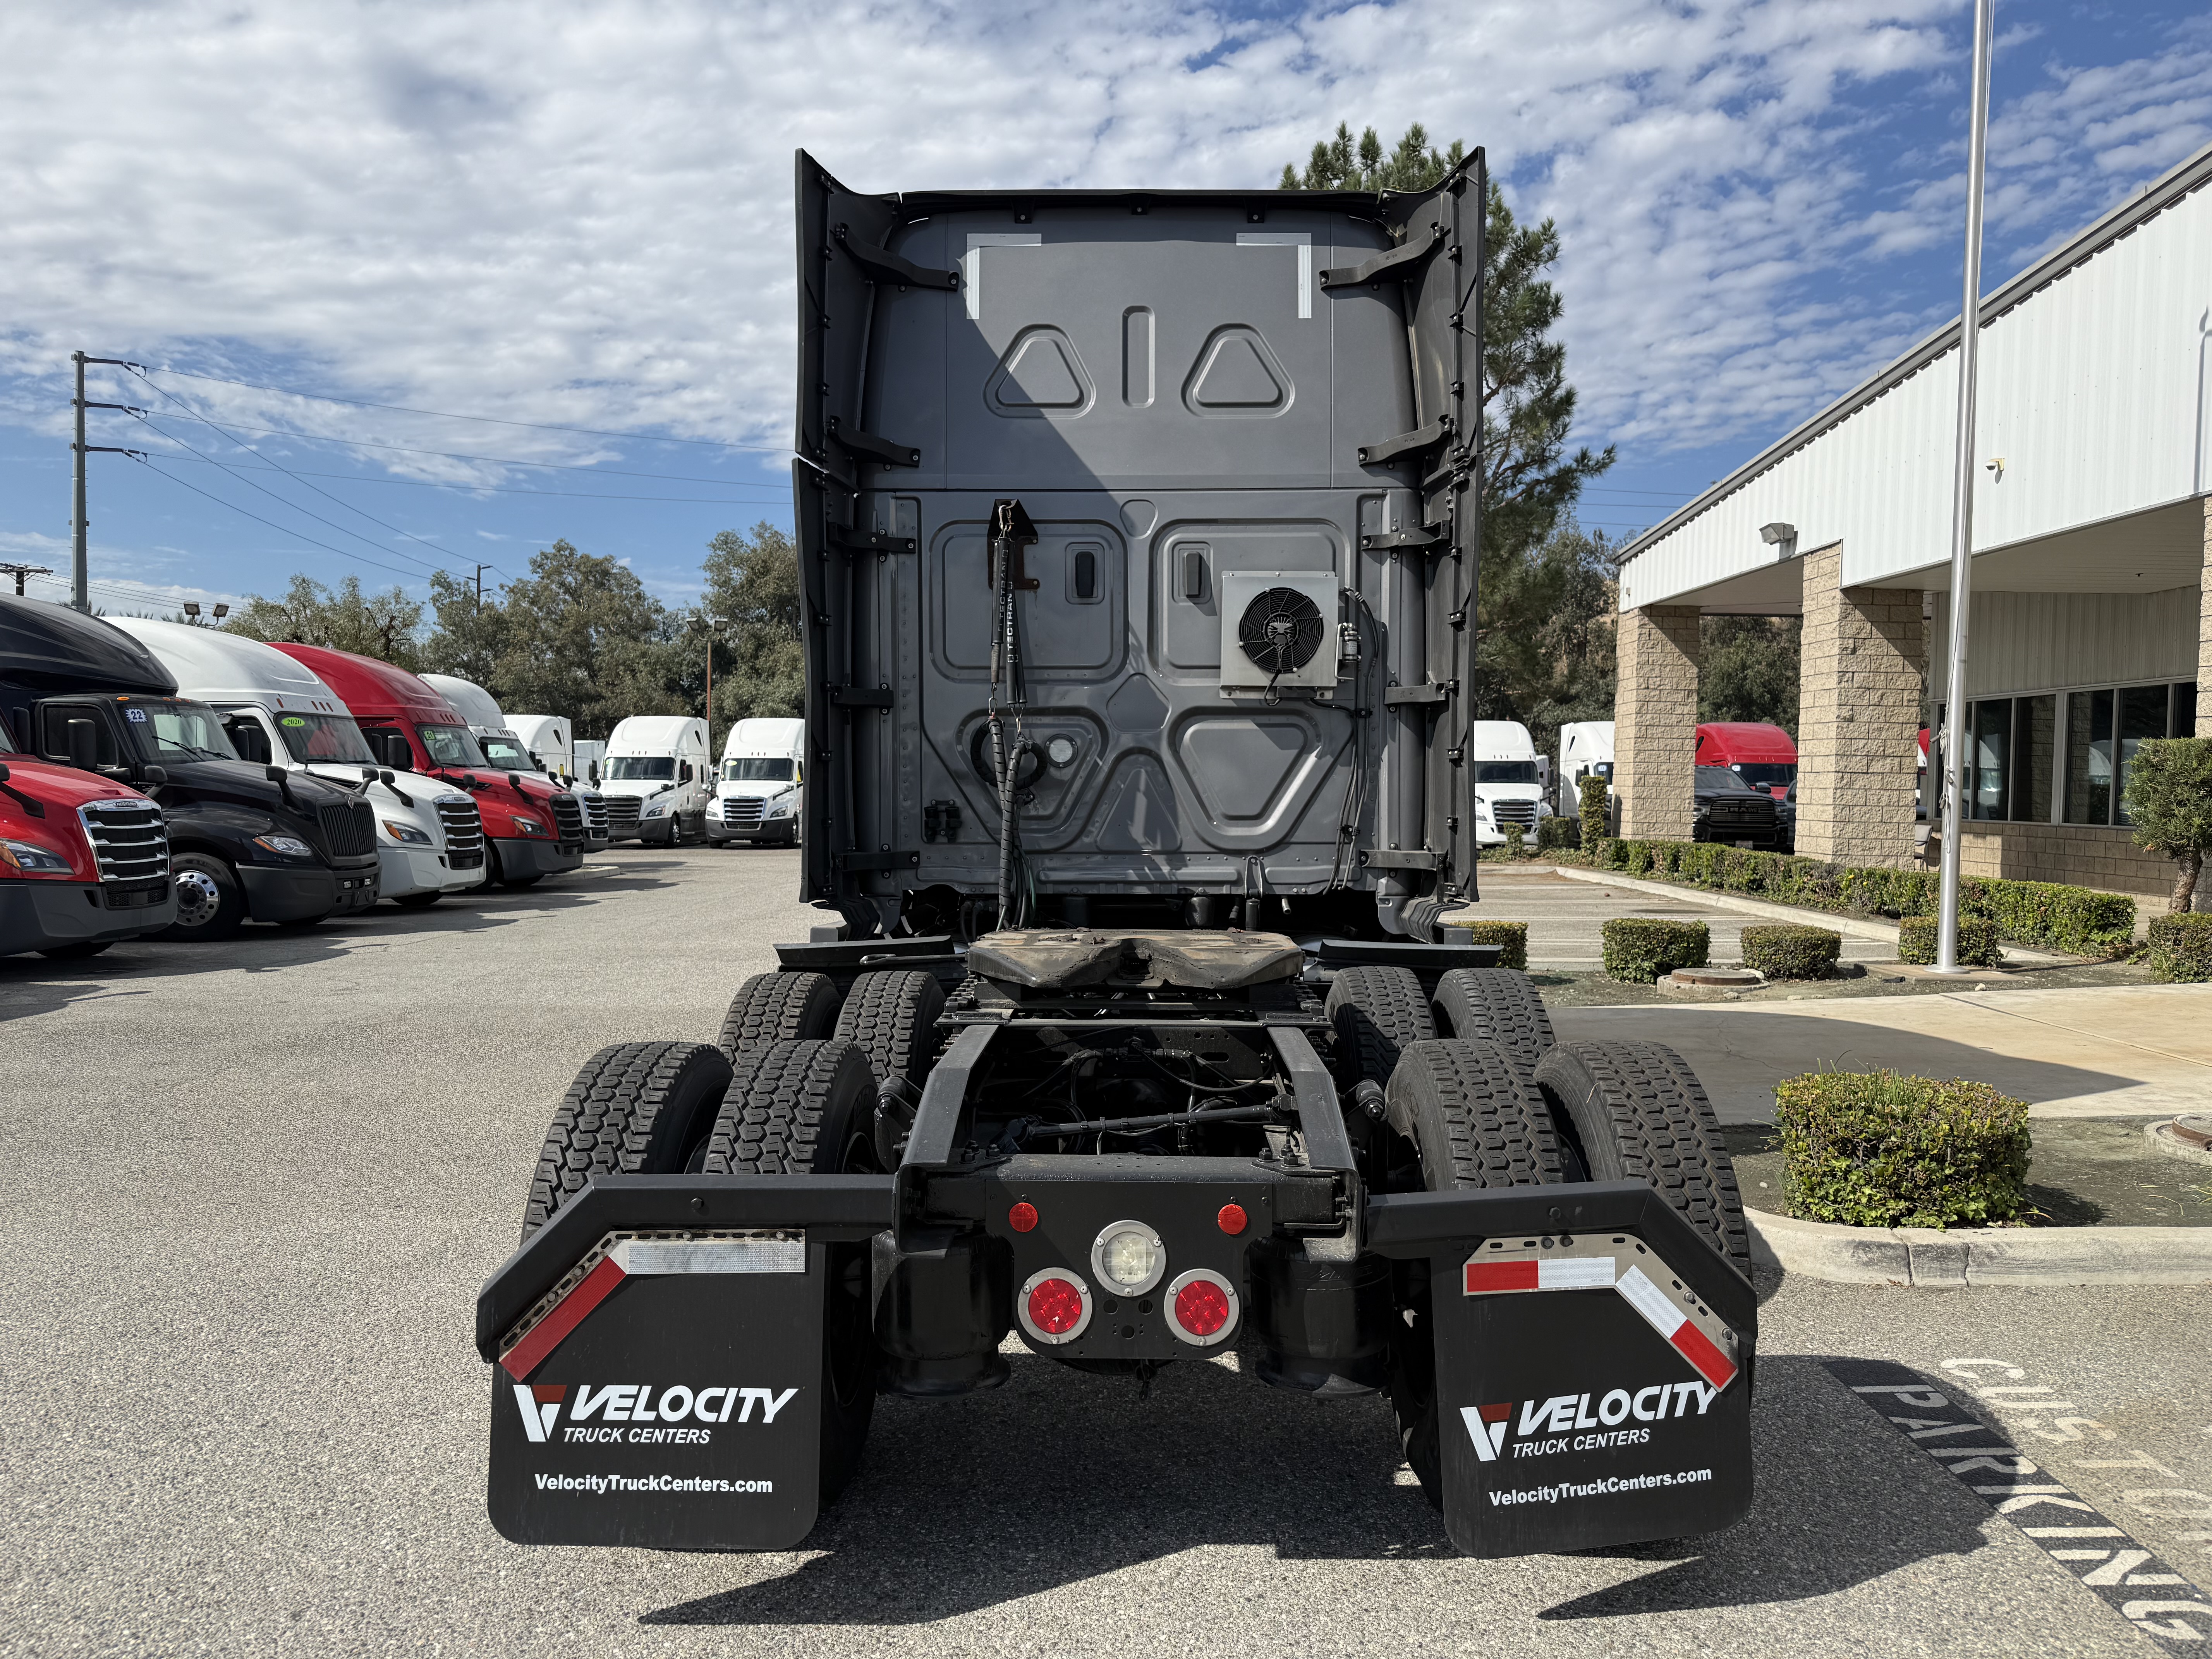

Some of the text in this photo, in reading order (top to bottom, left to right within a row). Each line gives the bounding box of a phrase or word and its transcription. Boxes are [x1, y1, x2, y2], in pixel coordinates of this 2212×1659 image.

[131, 711, 144, 720] 22
[570, 1385, 799, 1423] VELOCITY
[1518, 1381, 1717, 1436] VELOCITY
[564, 1427, 711, 1444] TRUCK CENTERS
[1513, 1428, 1650, 1458] TRUCK CENTERS
[535, 1474, 773, 1494] VelocityTruckCenters.com
[1489, 1469, 1712, 1506] VelocityTruckCenters.com
[1850, 1385, 2212, 1640] PARKING
